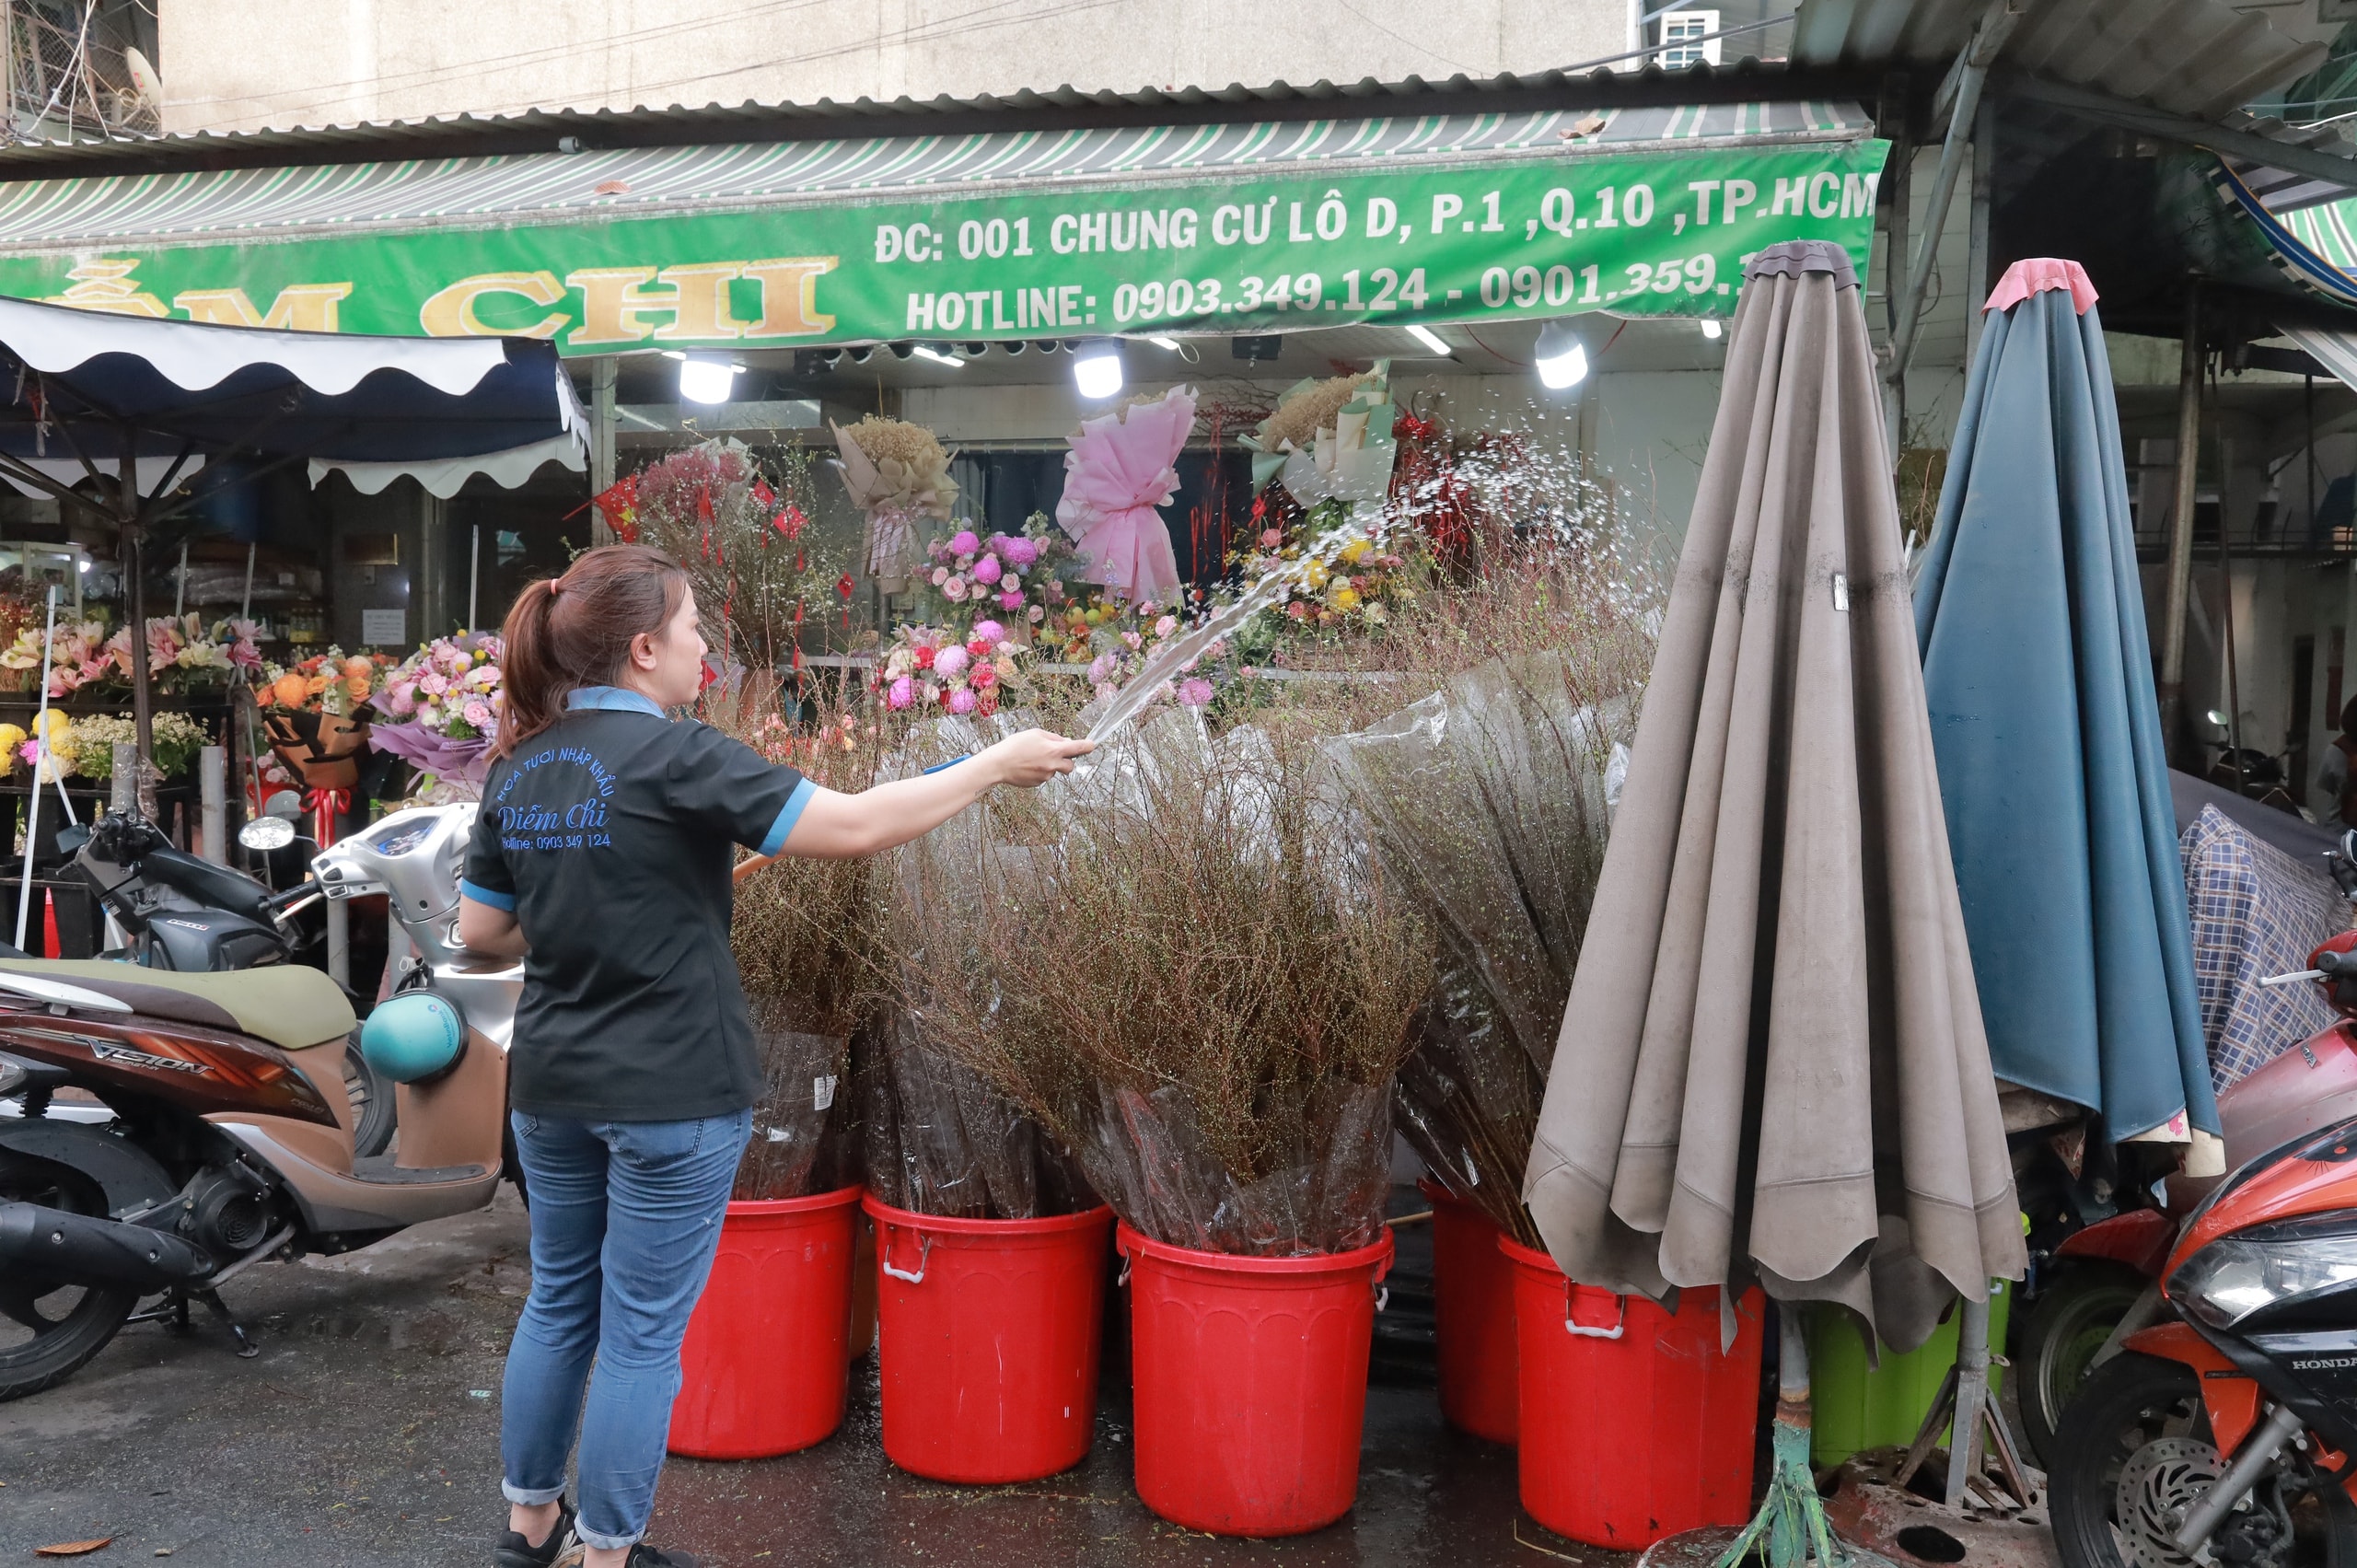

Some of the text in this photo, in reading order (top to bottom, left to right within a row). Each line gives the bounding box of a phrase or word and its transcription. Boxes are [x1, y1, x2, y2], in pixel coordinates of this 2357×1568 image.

[875, 222, 943, 263] ĐC:
[958, 216, 1034, 260] 001
[1050, 208, 1198, 254] CHUNG
[1212, 195, 1278, 246] CƯ
[1289, 189, 1348, 242] LÔ
[1365, 196, 1411, 244] D,
[1430, 190, 1505, 235] P.1
[420, 255, 840, 345] CHI
[906, 285, 1097, 331] HOTLINE:
[1112, 267, 1429, 322] 0903.349.124
[496, 747, 617, 802] HOA TƯƠI NHẬP KHẨU
[497, 797, 611, 831] Diễm Chi
[537, 835, 563, 850] 0903
[566, 834, 583, 849] 349
[587, 833, 611, 848] 124
